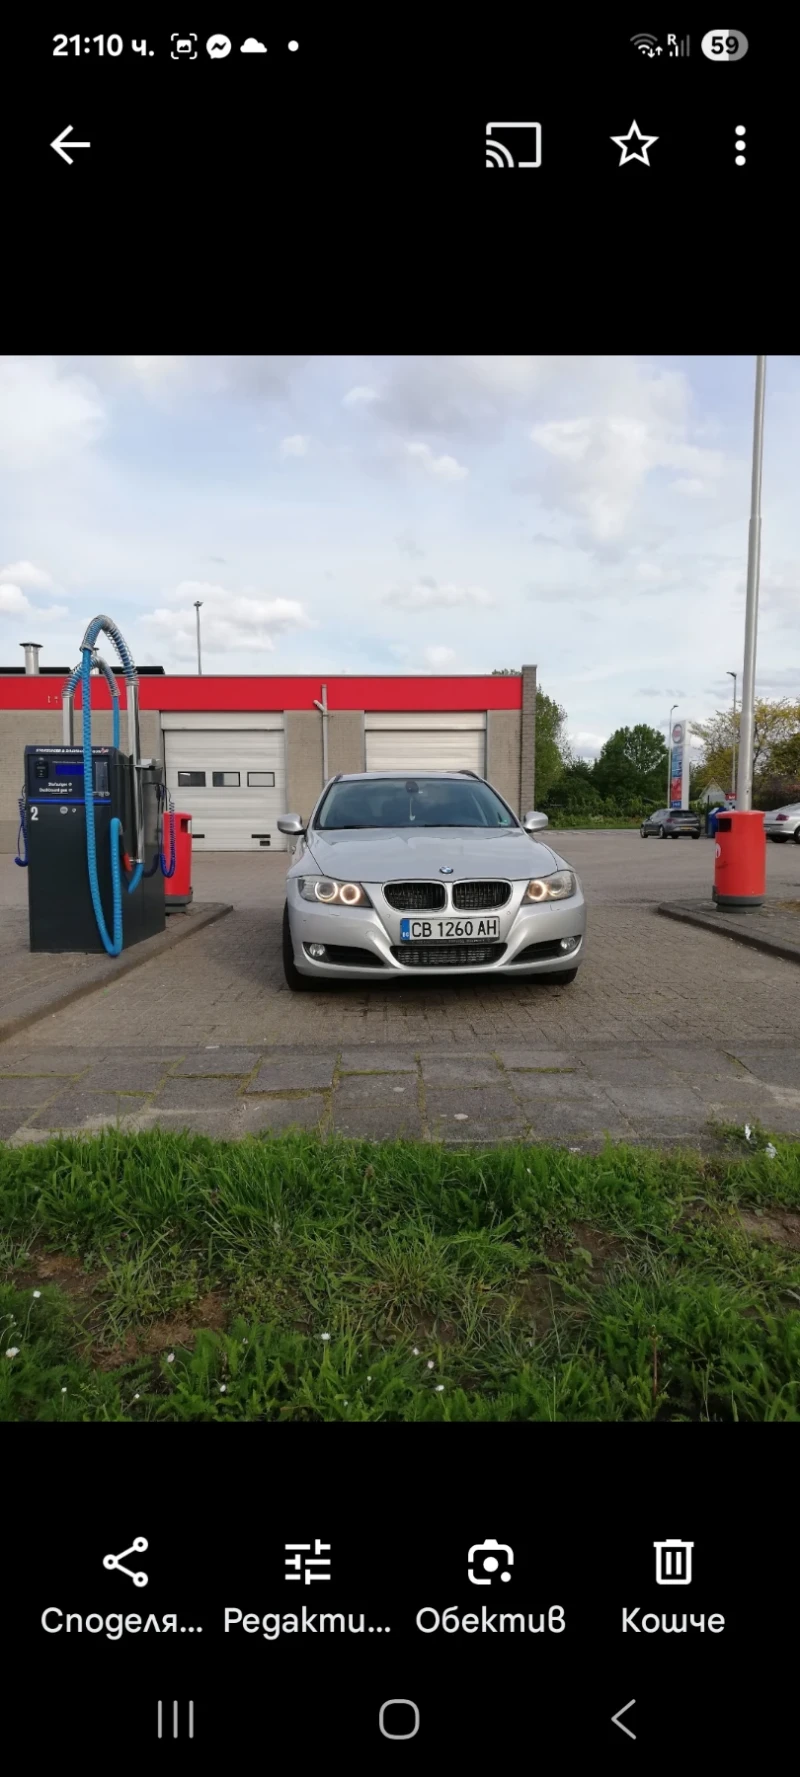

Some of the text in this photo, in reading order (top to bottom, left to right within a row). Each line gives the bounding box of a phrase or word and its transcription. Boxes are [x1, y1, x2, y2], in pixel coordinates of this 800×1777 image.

[30, 806, 39, 822] 2
[411, 919, 498, 938] CB 1260 AH
